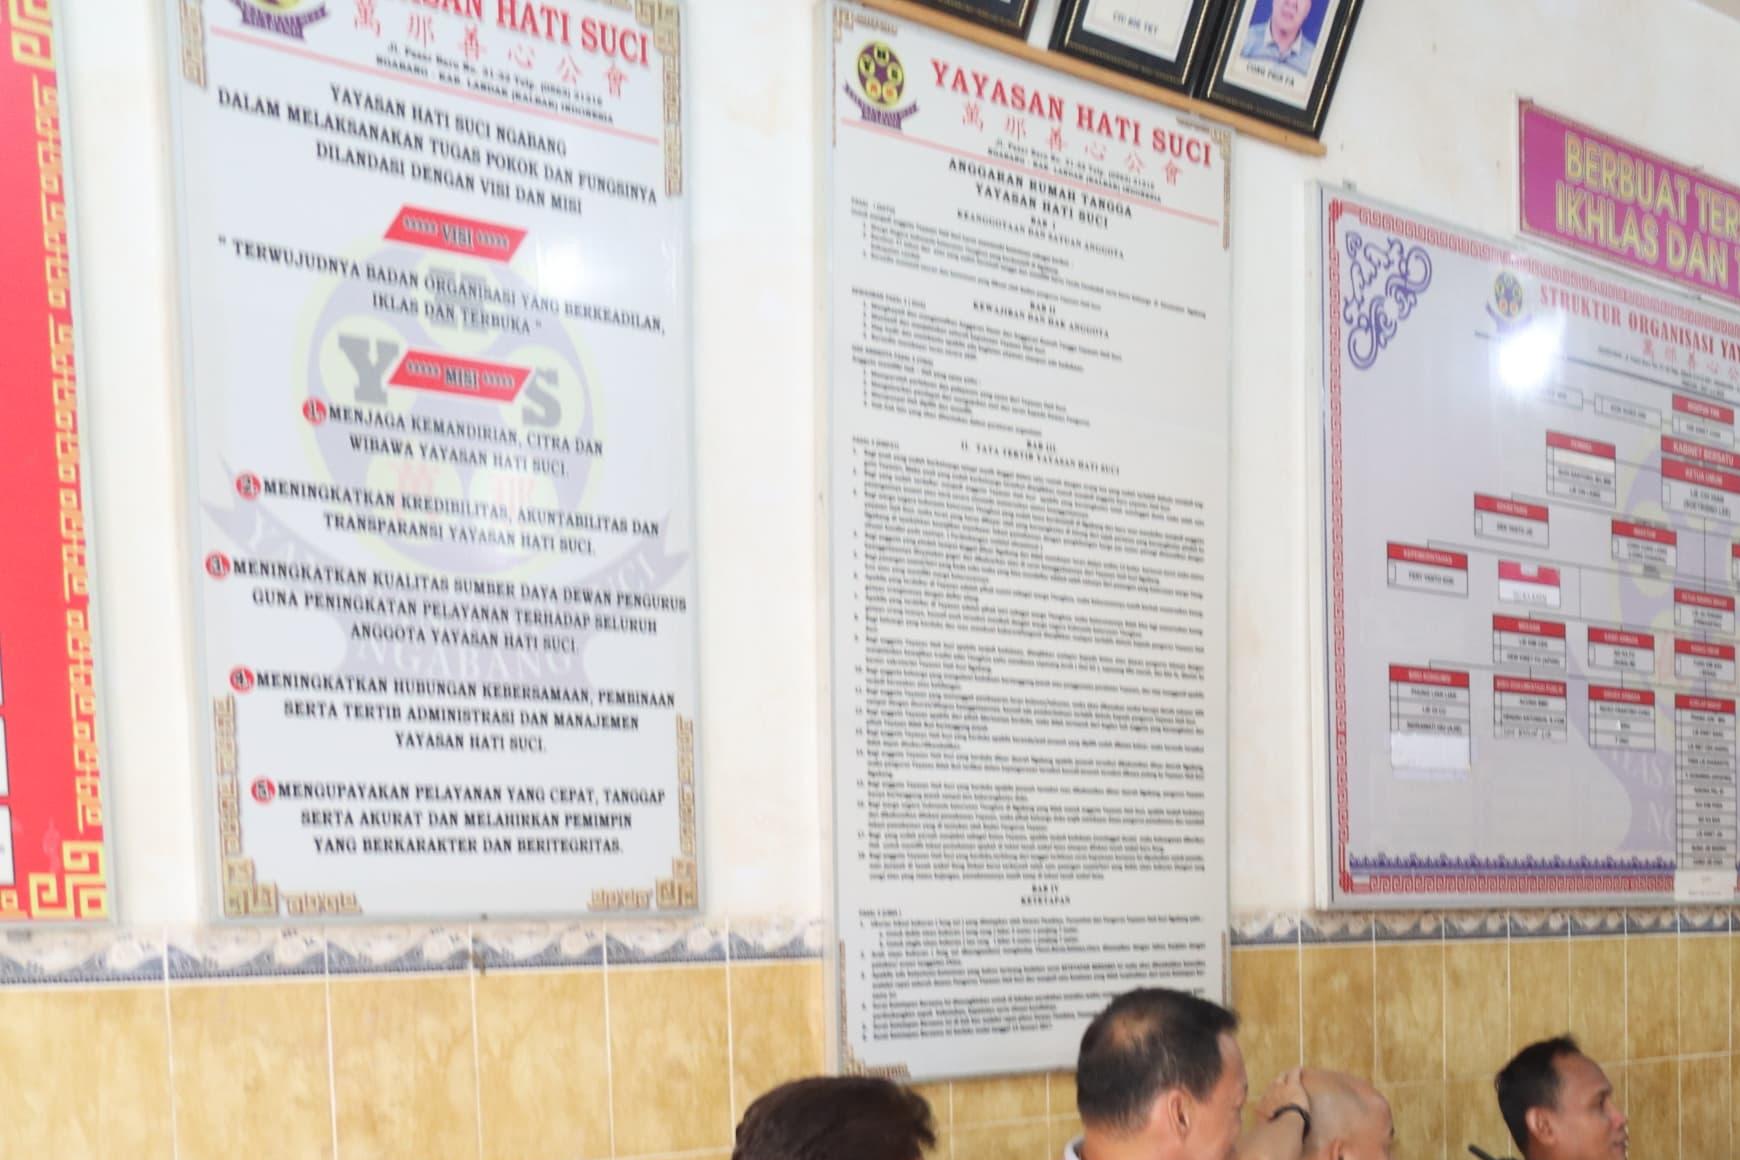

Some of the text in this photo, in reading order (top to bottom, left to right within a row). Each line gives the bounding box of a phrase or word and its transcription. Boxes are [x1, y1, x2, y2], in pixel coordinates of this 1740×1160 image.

[496, 0, 570, 46] HATI
[581, 18, 648, 65] SUCI
[330, 82, 567, 157] YAYASAN HATI SUCI NGABANG
[930, 58, 1064, 121] YAYASAN
[1076, 105, 1142, 146] HATI
[1151, 128, 1213, 169] SUCI
[218, 89, 657, 205] DALAM MELAKSANAKAN TUGAS POKOK DAN FUNGSINYA
[316, 141, 583, 215] DILANDASI DENGAN VISI DAN MISI
[949, 158, 1133, 219] ANGGARAN RUMAH TANGGA
[1564, 131, 1688, 219] BERBUAT
[974, 182, 1109, 229] YAYASAN HATI SUCI
[441, 225, 472, 247] VISI
[1555, 178, 1659, 264] IKHLAS
[1666, 224, 1729, 286] DAN
[233, 239, 361, 279] TERWUJUDNYA
[366, 264, 419, 290] BADAN
[521, 290, 560, 313] YANG
[372, 293, 531, 334] IKLAS DAN TERBUKA
[1540, 283, 1621, 328] STRUKTUR
[1628, 313, 1715, 355] ORGANISASI
[445, 367, 479, 389] MISI
[329, 405, 406, 432] MENJAGA
[527, 432, 570, 454] CITRA
[575, 439, 603, 457] DAN
[350, 436, 415, 457] WIBAWA
[419, 444, 488, 468] YAYASAN
[492, 454, 528, 473] HATI
[264, 478, 396, 508] MENINGKATKAN
[632, 519, 660, 537] DAN
[323, 512, 444, 540] TRANSPARANSI
[449, 525, 515, 547] YAYASAN
[520, 535, 556, 552] HATI
[233, 559, 368, 586] MENINGKATKAN
[373, 571, 450, 593] KUALITAS
[454, 577, 515, 597] SUMBER
[520, 583, 558, 601] DAYA
[563, 587, 613, 605] DEWAN
[252, 587, 300, 608] GUNA
[304, 590, 419, 618] PENINGKATAN
[423, 602, 510, 624] PELAYANAN
[351, 621, 426, 643] ANGGOTA
[431, 629, 499, 648] YAYASAN
[503, 634, 539, 651] HATI
[257, 671, 388, 694] MENINGKATKAN
[284, 700, 339, 719] SERTA
[520, 711, 549, 728] DAN
[395, 732, 464, 751] YAYASAN
[469, 734, 505, 752] HATI
[278, 783, 409, 801] MENGUPAYAKAN
[415, 785, 502, 802] PELAYANAN
[507, 786, 545, 803] YANG
[300, 810, 354, 827] SERTA
[360, 810, 423, 827] AKURAT
[428, 811, 459, 828] DAN
[314, 838, 357, 854] YANG
[482, 838, 513, 854] DAN
